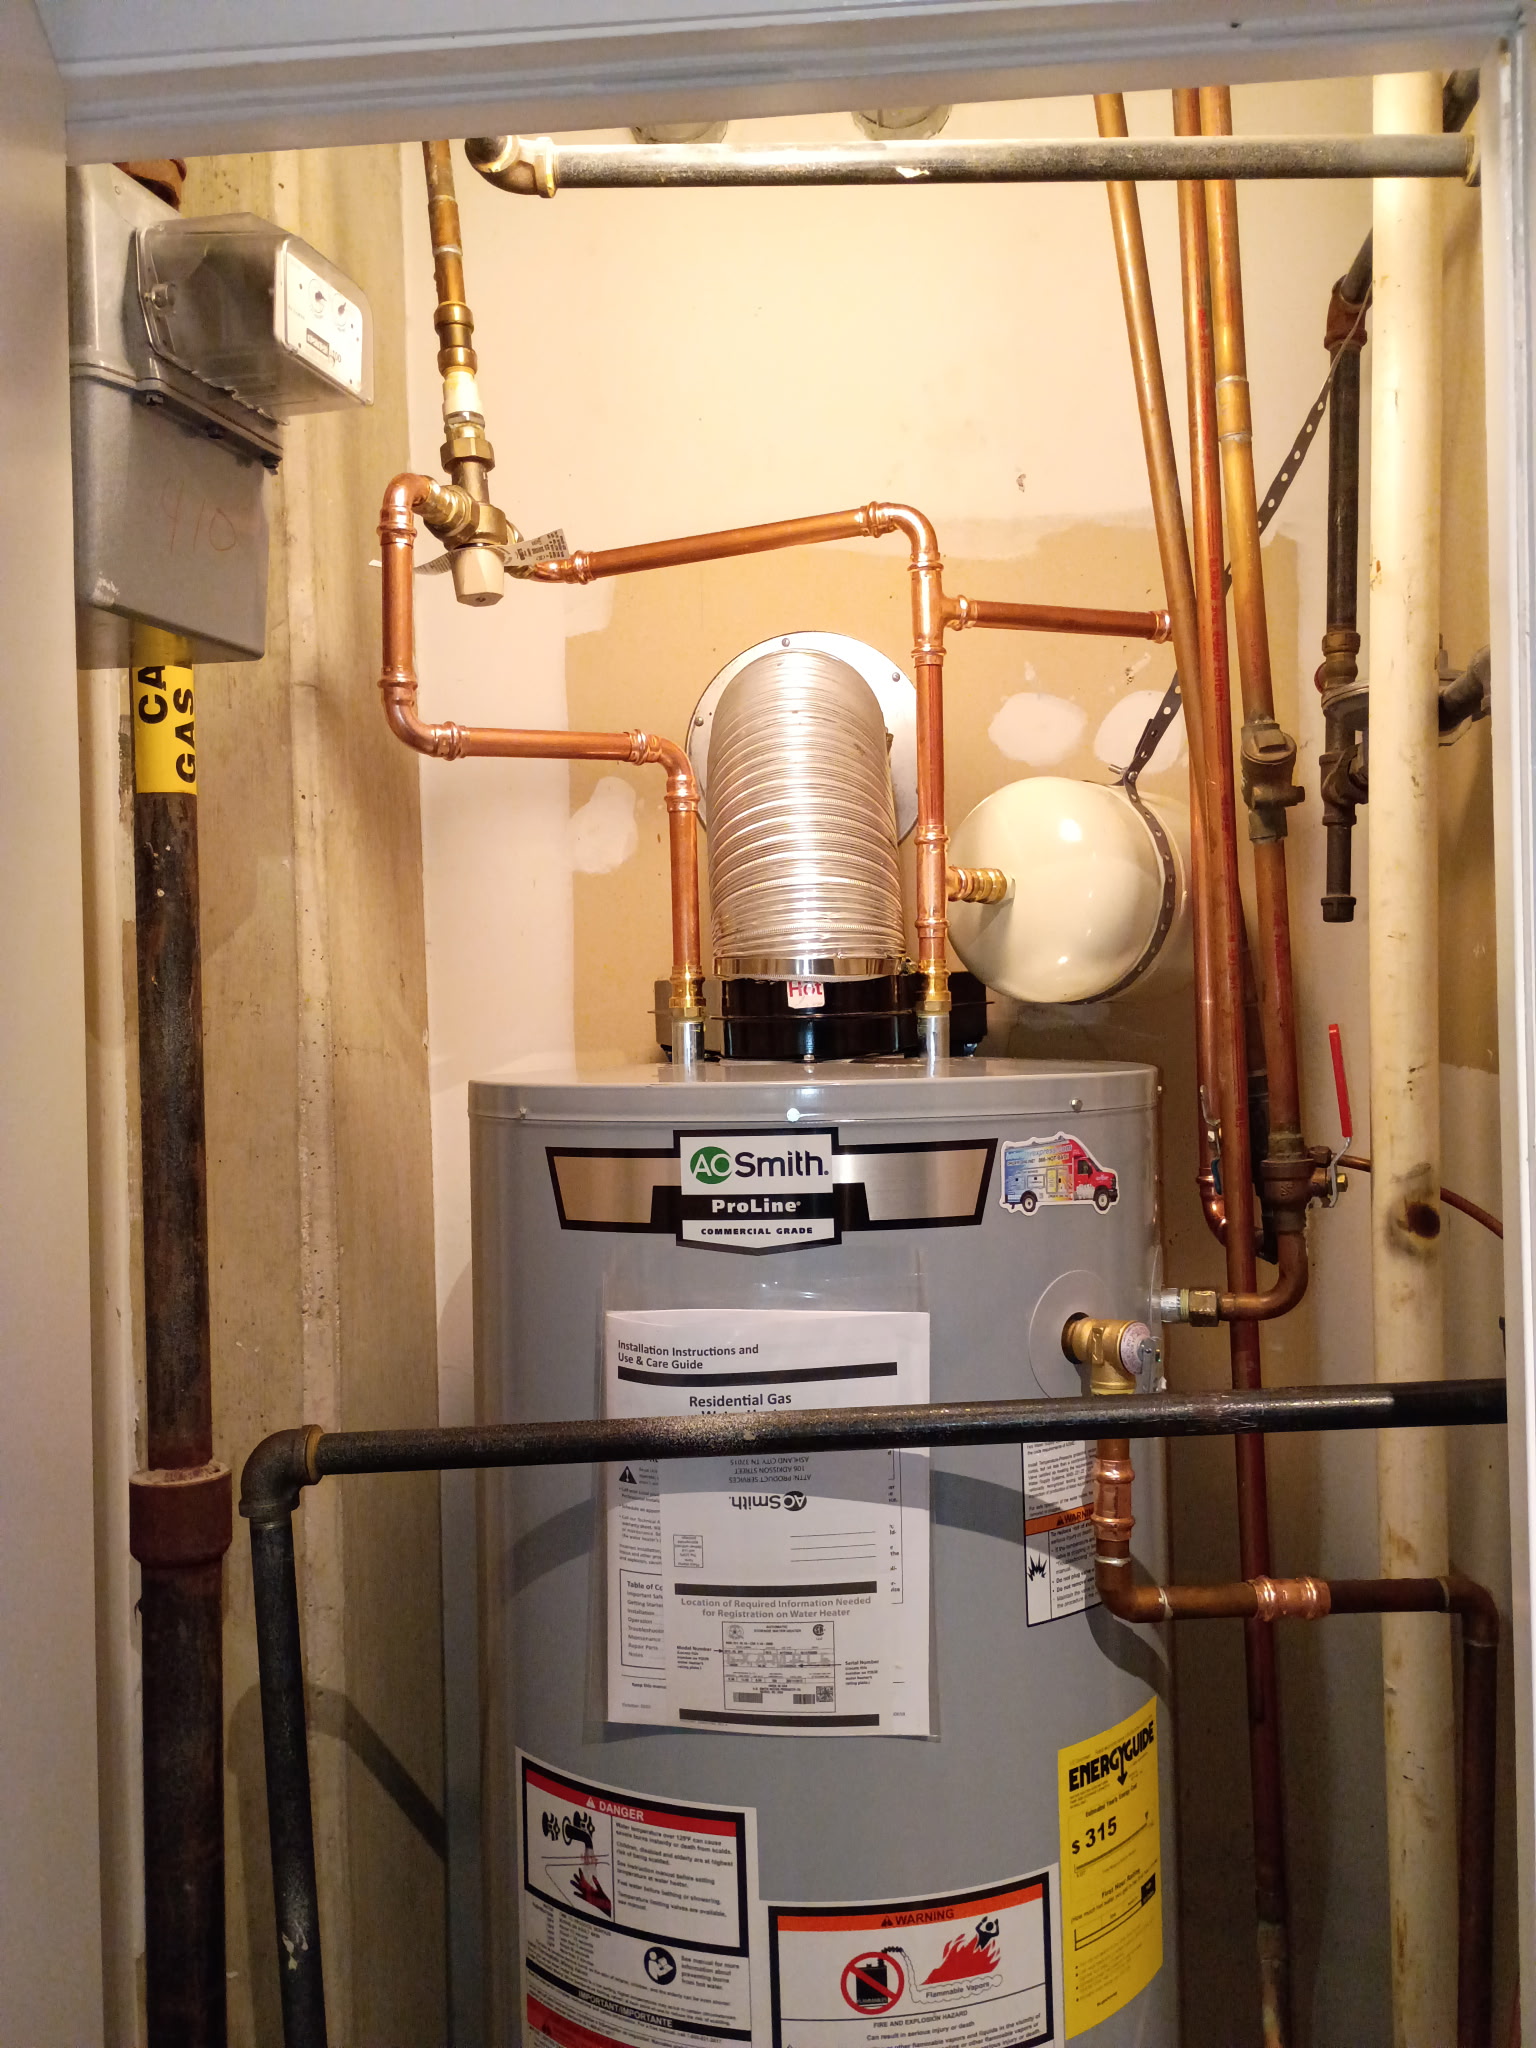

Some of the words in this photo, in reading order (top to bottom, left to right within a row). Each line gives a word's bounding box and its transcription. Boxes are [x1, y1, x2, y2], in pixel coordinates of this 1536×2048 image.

[172, 687, 196, 784] GAS
[788, 981, 823, 997] Hot
[711, 1197, 797, 1213] ProLine
[776, 1227, 813, 1235] GRADE
[618, 1340, 669, 1356] Installation
[672, 1346, 736, 1357] Instructions
[738, 1344, 759, 1355] and
[618, 1352, 634, 1364] Use
[636, 1356, 644, 1366] &
[646, 1357, 669, 1369] Care
[671, 1360, 703, 1370] Guide
[689, 1393, 763, 1407] Residential
[767, 1393, 792, 1405] Gas
[728, 1476, 759, 1484] SERVICES
[760, 1475, 792, 1483] PRODUCT
[626, 1580, 645, 1590] Table
[645, 1583, 654, 1591] of
[680, 1597, 722, 1608] Location
[722, 1599, 733, 1608] of
[733, 1600, 776, 1610] Required
[778, 1599, 834, 1609] Information
[835, 1596, 872, 1607] Needed
[702, 1608, 716, 1617] for
[717, 1609, 774, 1620] Registration
[776, 1610, 789, 1619] on
[789, 1609, 818, 1618] Water
[819, 1608, 851, 1617] Heater
[598, 1800, 645, 1823] DANGER
[1085, 1815, 1117, 1848] 315
[894, 1908, 956, 1927] WARNING
[925, 1987, 964, 1999] Flammable
[966, 1981, 990, 1992] Vapors
[873, 2021, 888, 2029] FIRE
[889, 2019, 904, 2027] AND
[904, 2014, 941, 2026] EXPLOSION
[942, 2009, 968, 2020] HAZARD
[880, 2032, 899, 2040] result
[907, 2028, 931, 2037] serious
[931, 2026, 949, 2035] injury
[958, 2021, 975, 2030] death
